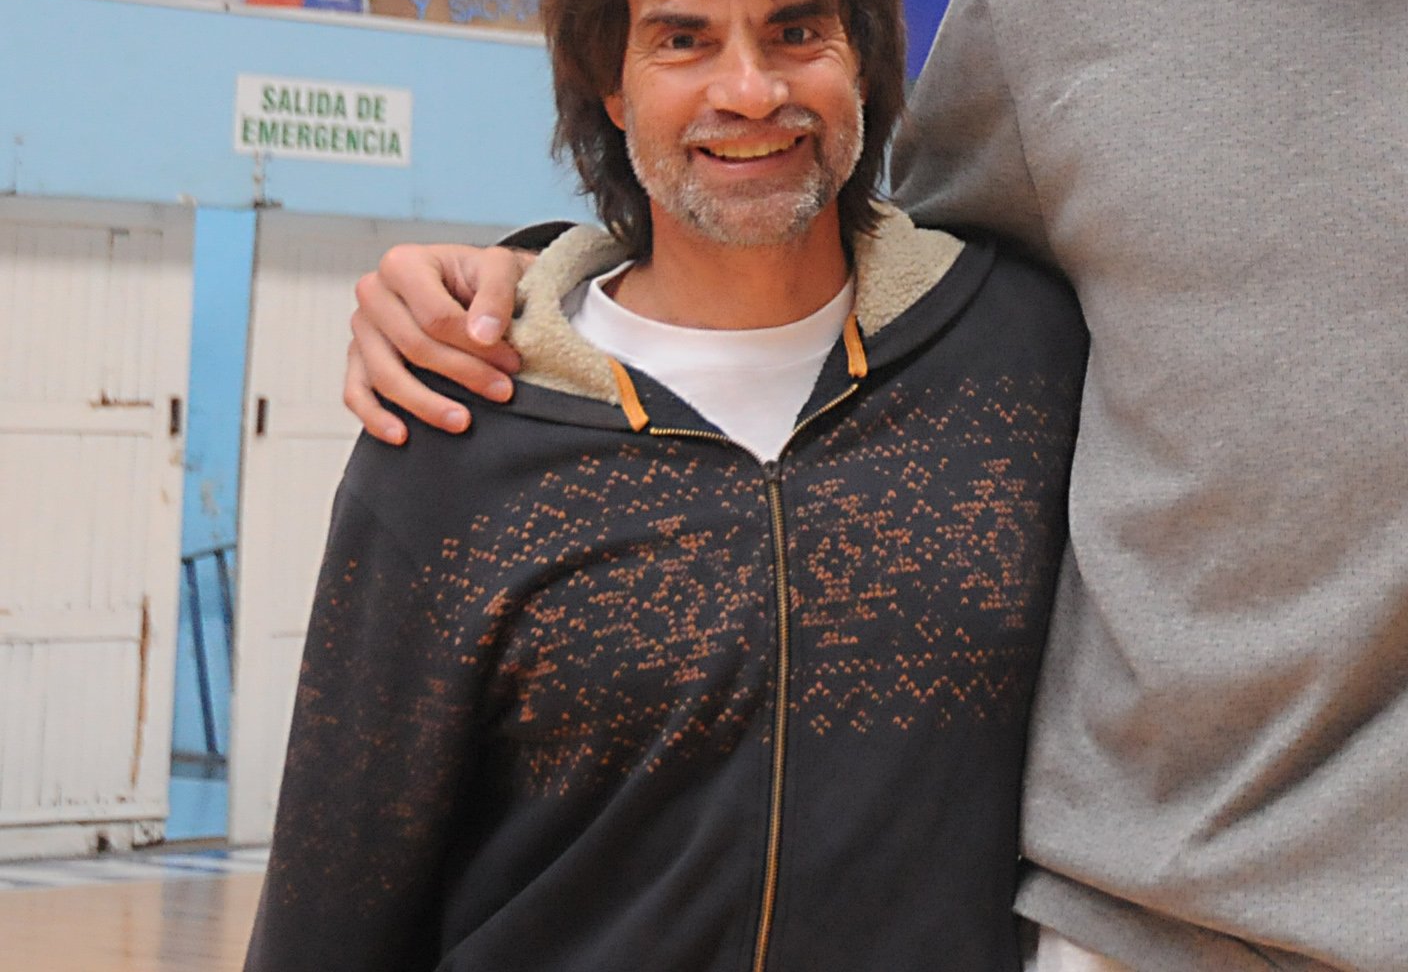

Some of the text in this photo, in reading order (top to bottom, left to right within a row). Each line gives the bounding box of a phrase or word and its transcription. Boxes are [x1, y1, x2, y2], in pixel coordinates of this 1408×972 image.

[261, 82, 388, 123] SALIDA DE
[241, 114, 403, 158] EMERGENCIA
